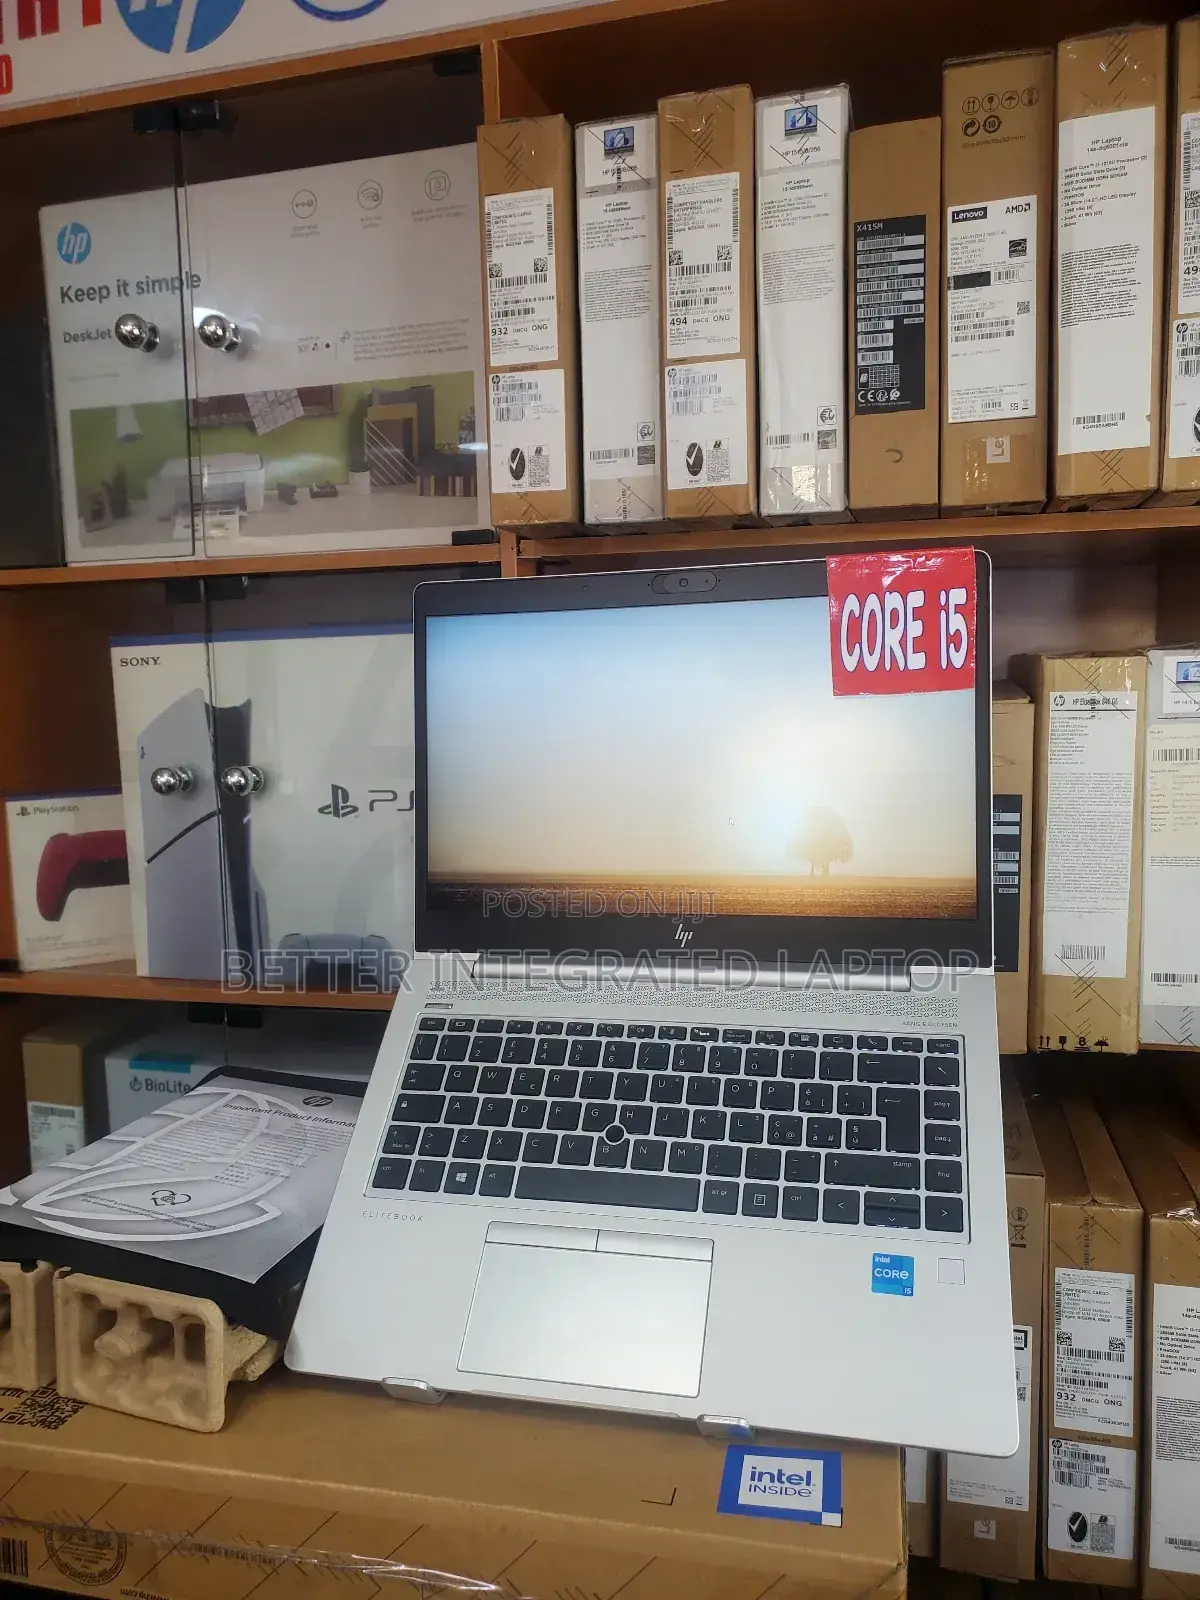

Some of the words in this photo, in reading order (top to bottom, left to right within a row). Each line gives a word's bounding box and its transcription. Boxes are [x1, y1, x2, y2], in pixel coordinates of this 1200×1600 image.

[954, 210, 986, 221] Lenovo
[1005, 203, 1024, 215] AMD
[857, 222, 884, 233] X415M
[1183, 267, 1200, 280] 49
[60, 285, 111, 304] Keep
[116, 279, 130, 298] it
[135, 271, 202, 296] simple
[669, 316, 688, 326] 494
[712, 314, 731, 322] ONG
[63, 328, 112, 344] DeskJet
[491, 326, 509, 337] 932
[531, 323, 548, 332] ONG
[840, 591, 927, 673] CORE
[938, 588, 970, 671] i5
[120, 656, 160, 667] SONY
[368, 789, 416, 812] PS
[33, 805, 79, 816] PlayStation
[144, 1079, 192, 1095] BioLite
[223, 1103, 273, 1116] Important
[273, 1109, 312, 1122] Product
[892, 1160, 912, 1168] stamp
[361, 1210, 425, 1223] ELITEBOOK
[874, 1255, 891, 1264] intel
[1056, 1391, 1076, 1402] 932
[1103, 1398, 1123, 1407] ONG
[749, 1465, 813, 1486] intel
